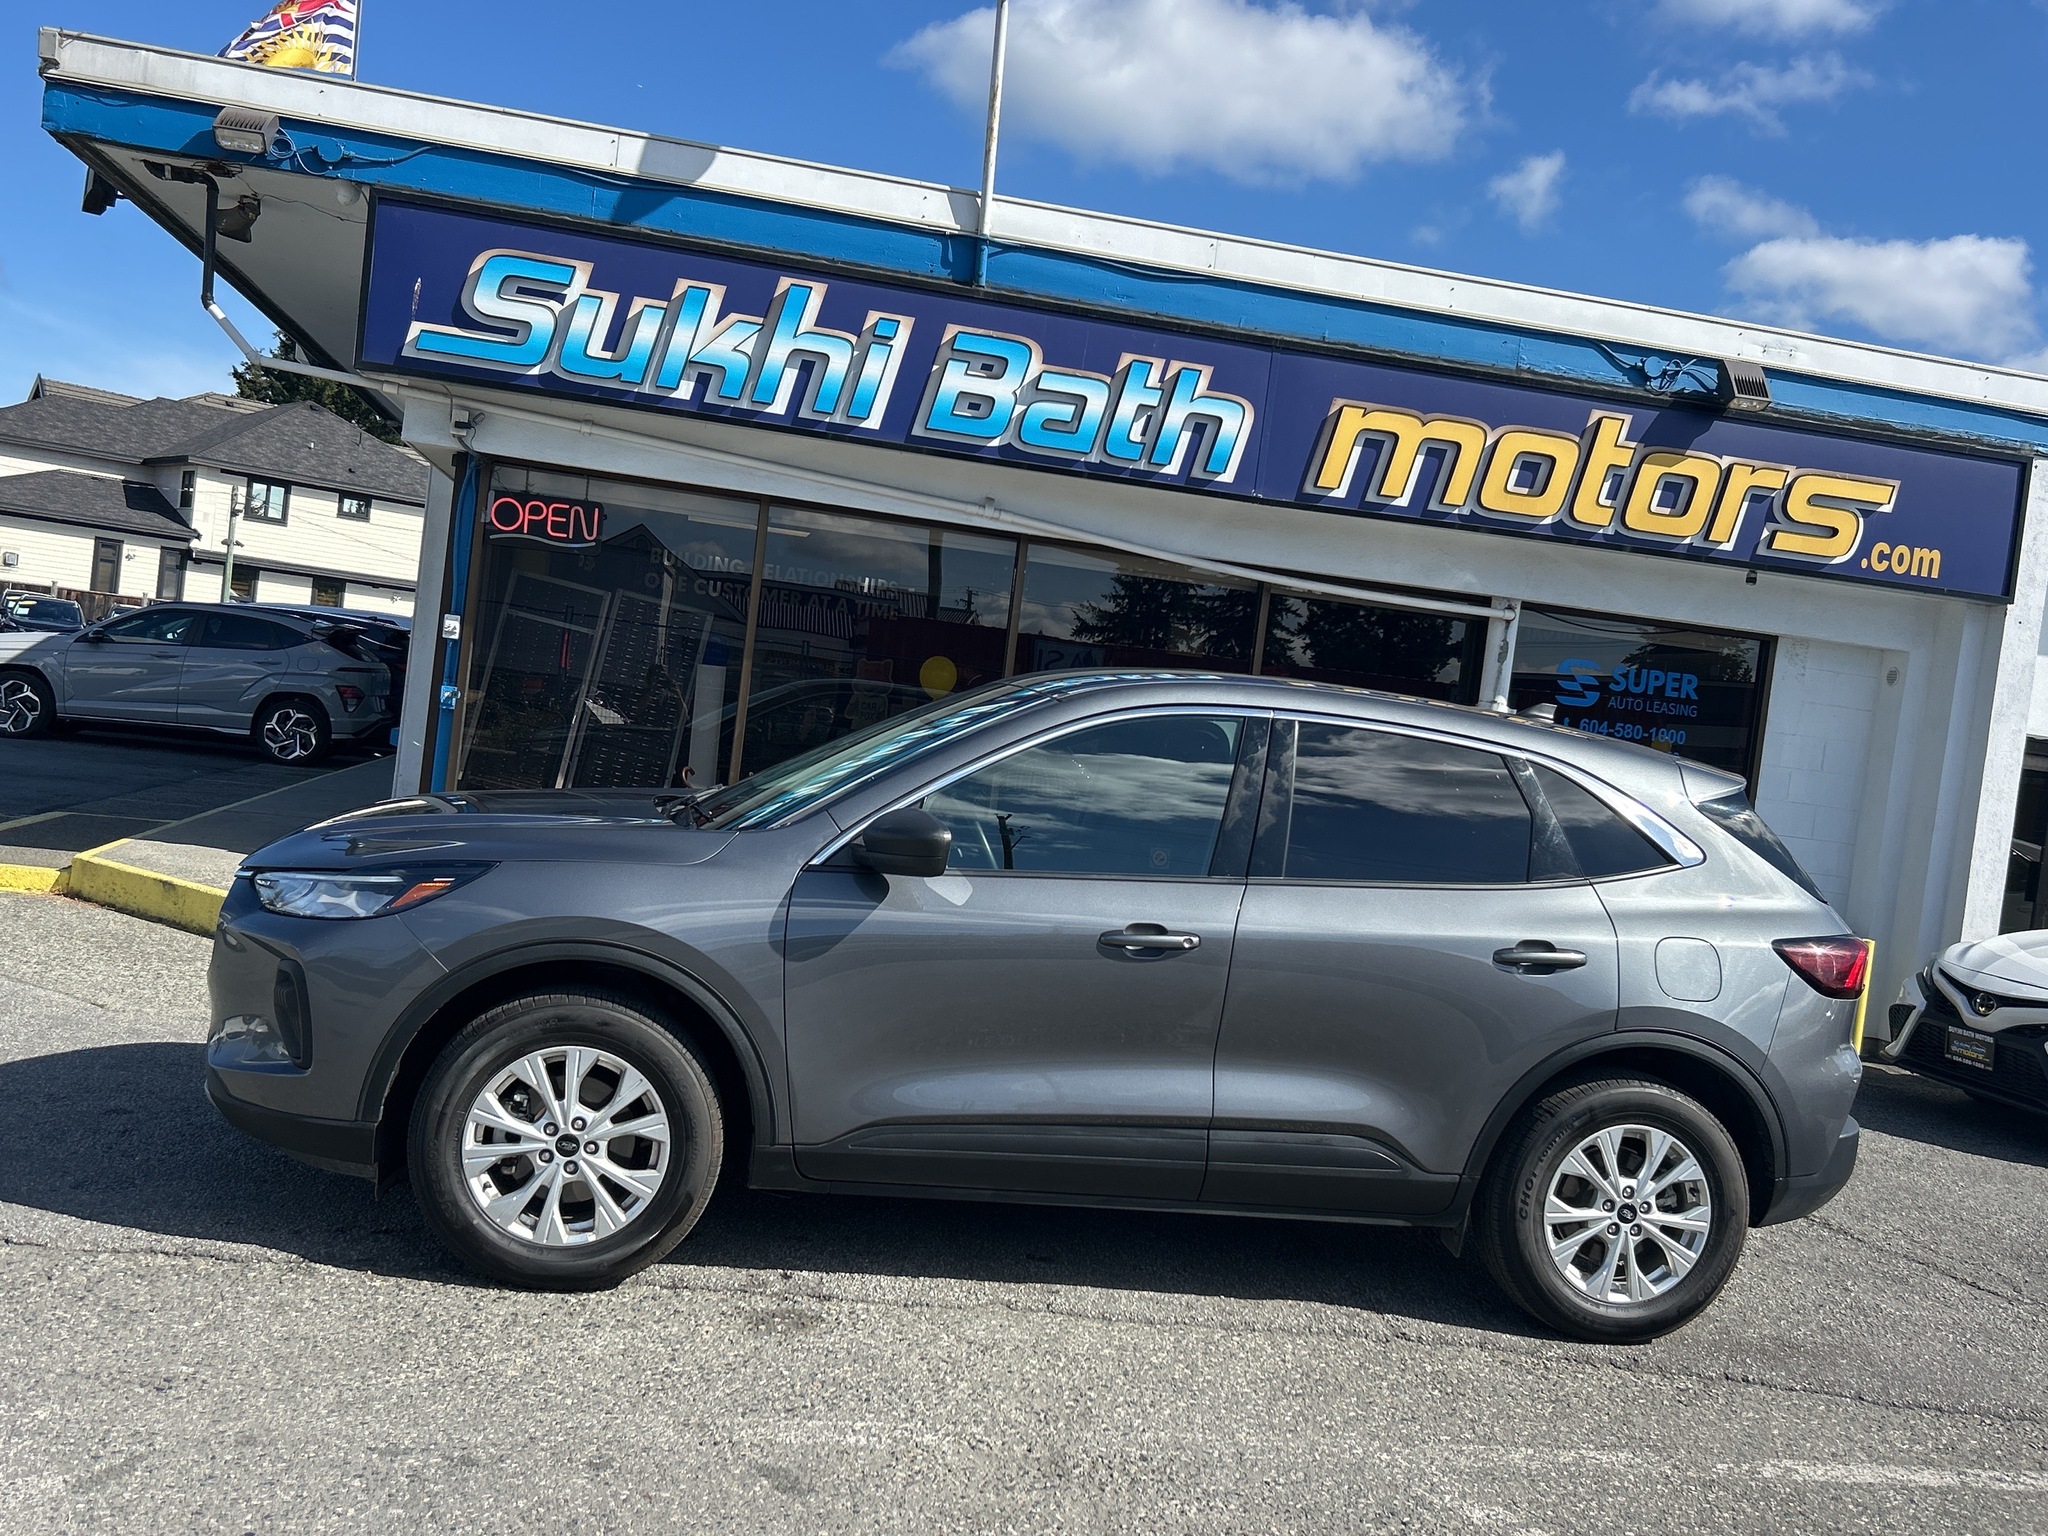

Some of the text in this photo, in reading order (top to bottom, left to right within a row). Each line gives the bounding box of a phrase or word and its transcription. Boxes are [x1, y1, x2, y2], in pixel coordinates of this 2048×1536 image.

[404, 249, 915, 430] Sukhi
[912, 322, 1254, 484] Bath
[1305, 397, 1900, 565] motors
[490, 496, 600, 542] OPEN
[760, 564, 899, 594] ELATIONSHIPS
[1608, 665, 1699, 700] SUPER
[1607, 696, 1698, 718] AUTO LEASING
[1579, 718, 1687, 745] 604-580-1000
